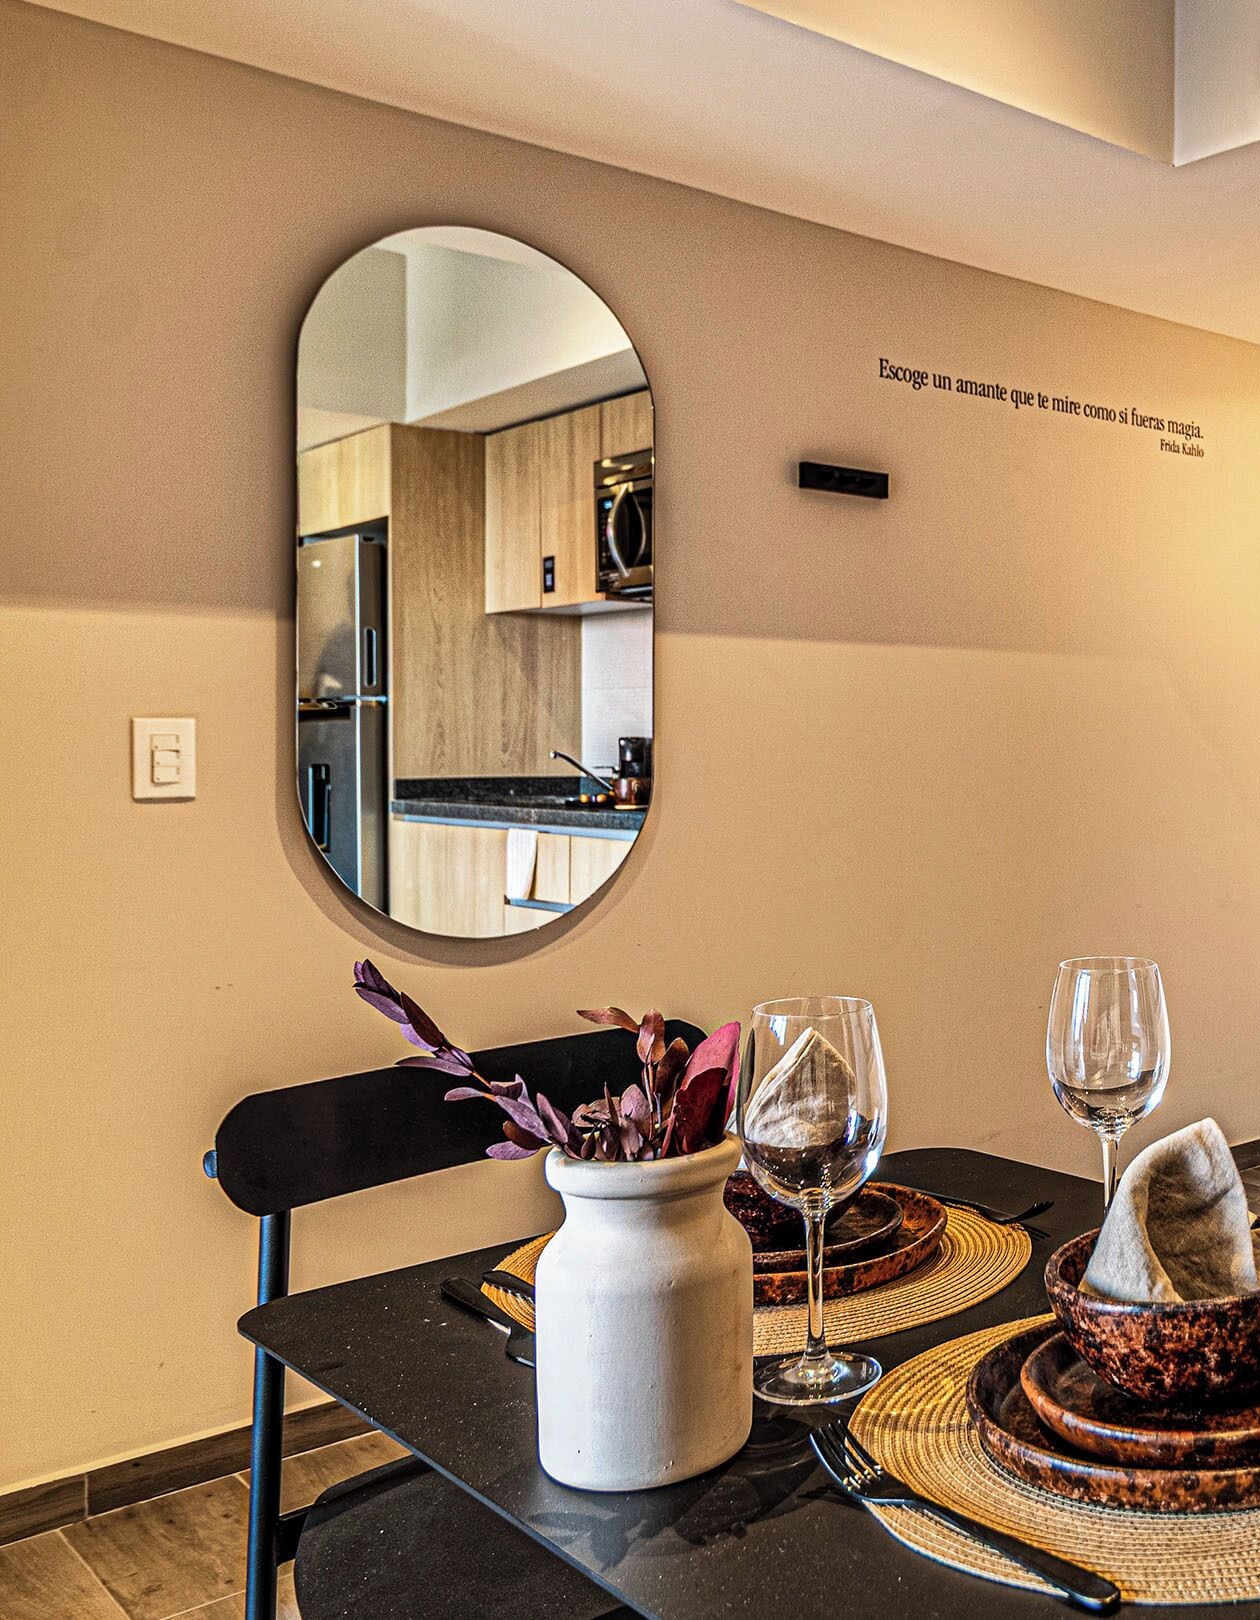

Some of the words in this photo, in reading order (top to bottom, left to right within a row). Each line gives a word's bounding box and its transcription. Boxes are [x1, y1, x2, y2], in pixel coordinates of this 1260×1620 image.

[879, 357, 929, 391] Escoge
[932, 373, 952, 391] un
[956, 378, 1007, 401] amante
[1010, 389, 1034, 409] que
[1037, 391, 1049, 409] te
[1052, 396, 1081, 416] mire
[1083, 403, 1117, 422] como
[1118, 407, 1128, 425] si
[1131, 407, 1165, 432] fueras
[1167, 419, 1204, 441] magia.
[1160, 439, 1180, 454] Frida
[1182, 442, 1205, 458] Kahlo
